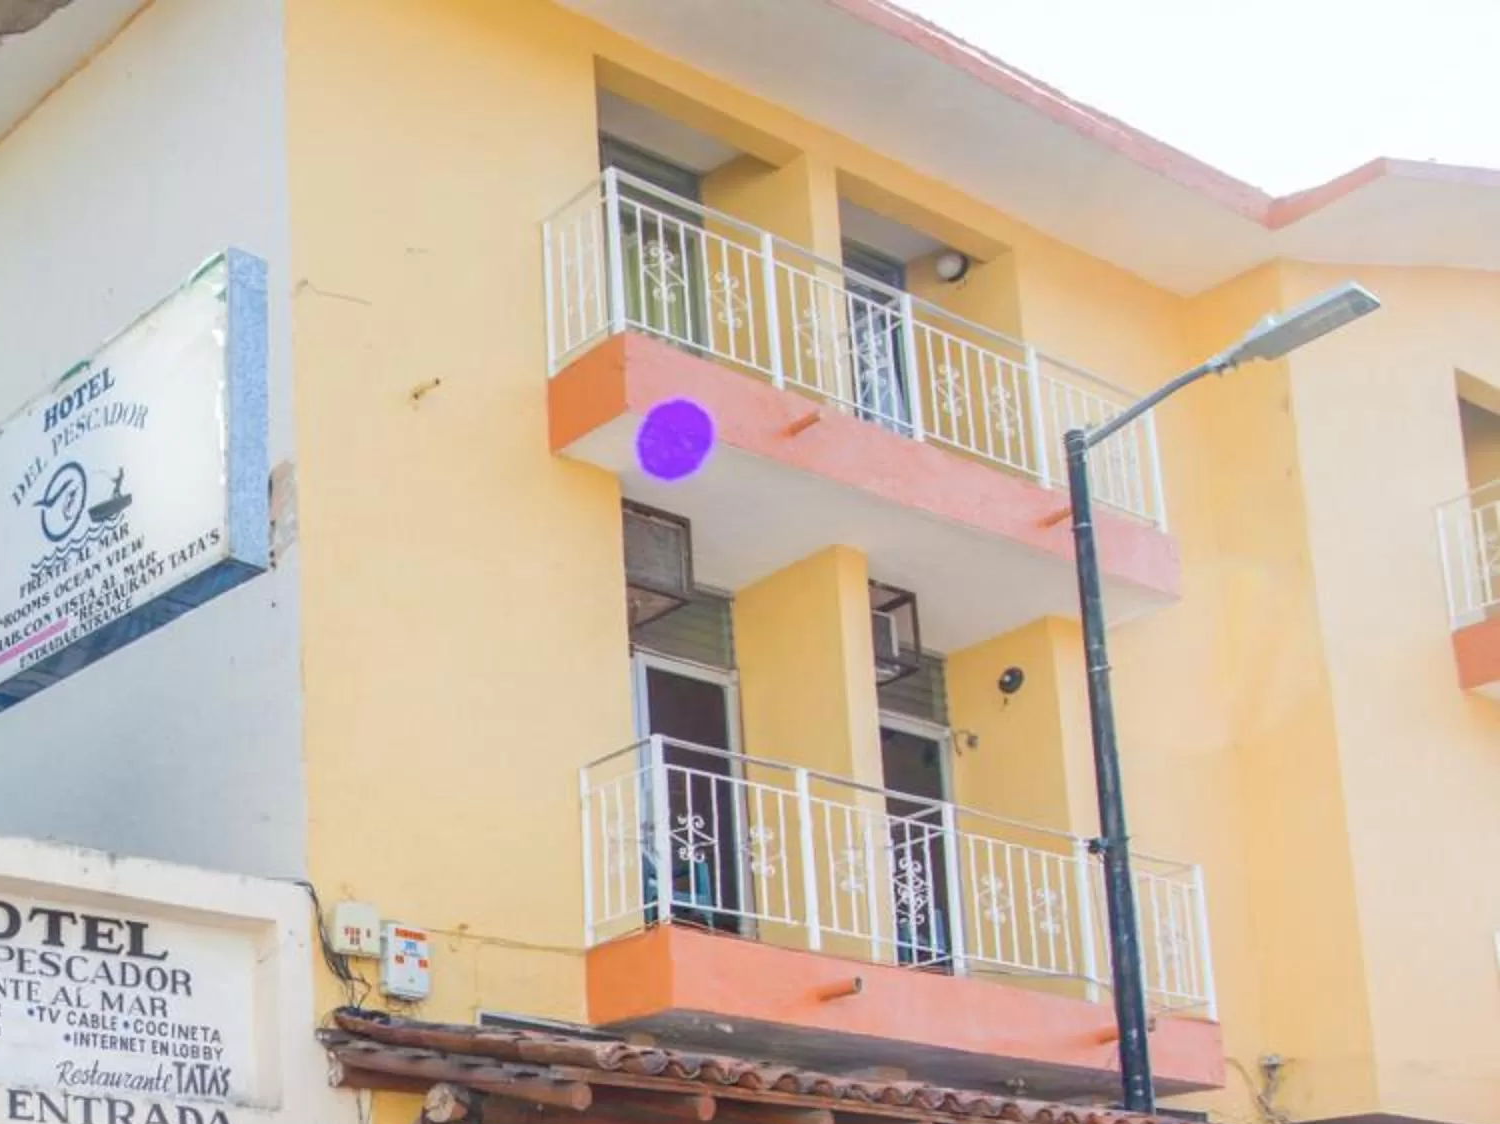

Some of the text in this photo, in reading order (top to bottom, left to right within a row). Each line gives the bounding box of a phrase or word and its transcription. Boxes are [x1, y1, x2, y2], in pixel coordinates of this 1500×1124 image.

[43, 367, 116, 432] HOTEL
[11, 401, 149, 506] DEL PESCADOR
[2, 534, 145, 629] ROOMS OCEAN VIEW
[20, 522, 130, 598] FRENTE AL MAR
[56, 588, 95, 618] VISTA
[100, 574, 117, 592] AL
[123, 550, 158, 578] MAR
[77, 527, 220, 621] RESTAURANT TATA'S
[36, 1006, 222, 1044] TV CABLE COCINETA
[50, 985, 91, 1009] AL
[101, 990, 169, 1018] MAR
[55, 1060, 232, 1097] Restaurante TATA'S
[72, 1031, 224, 1061] INTERNET EN LOBBY
